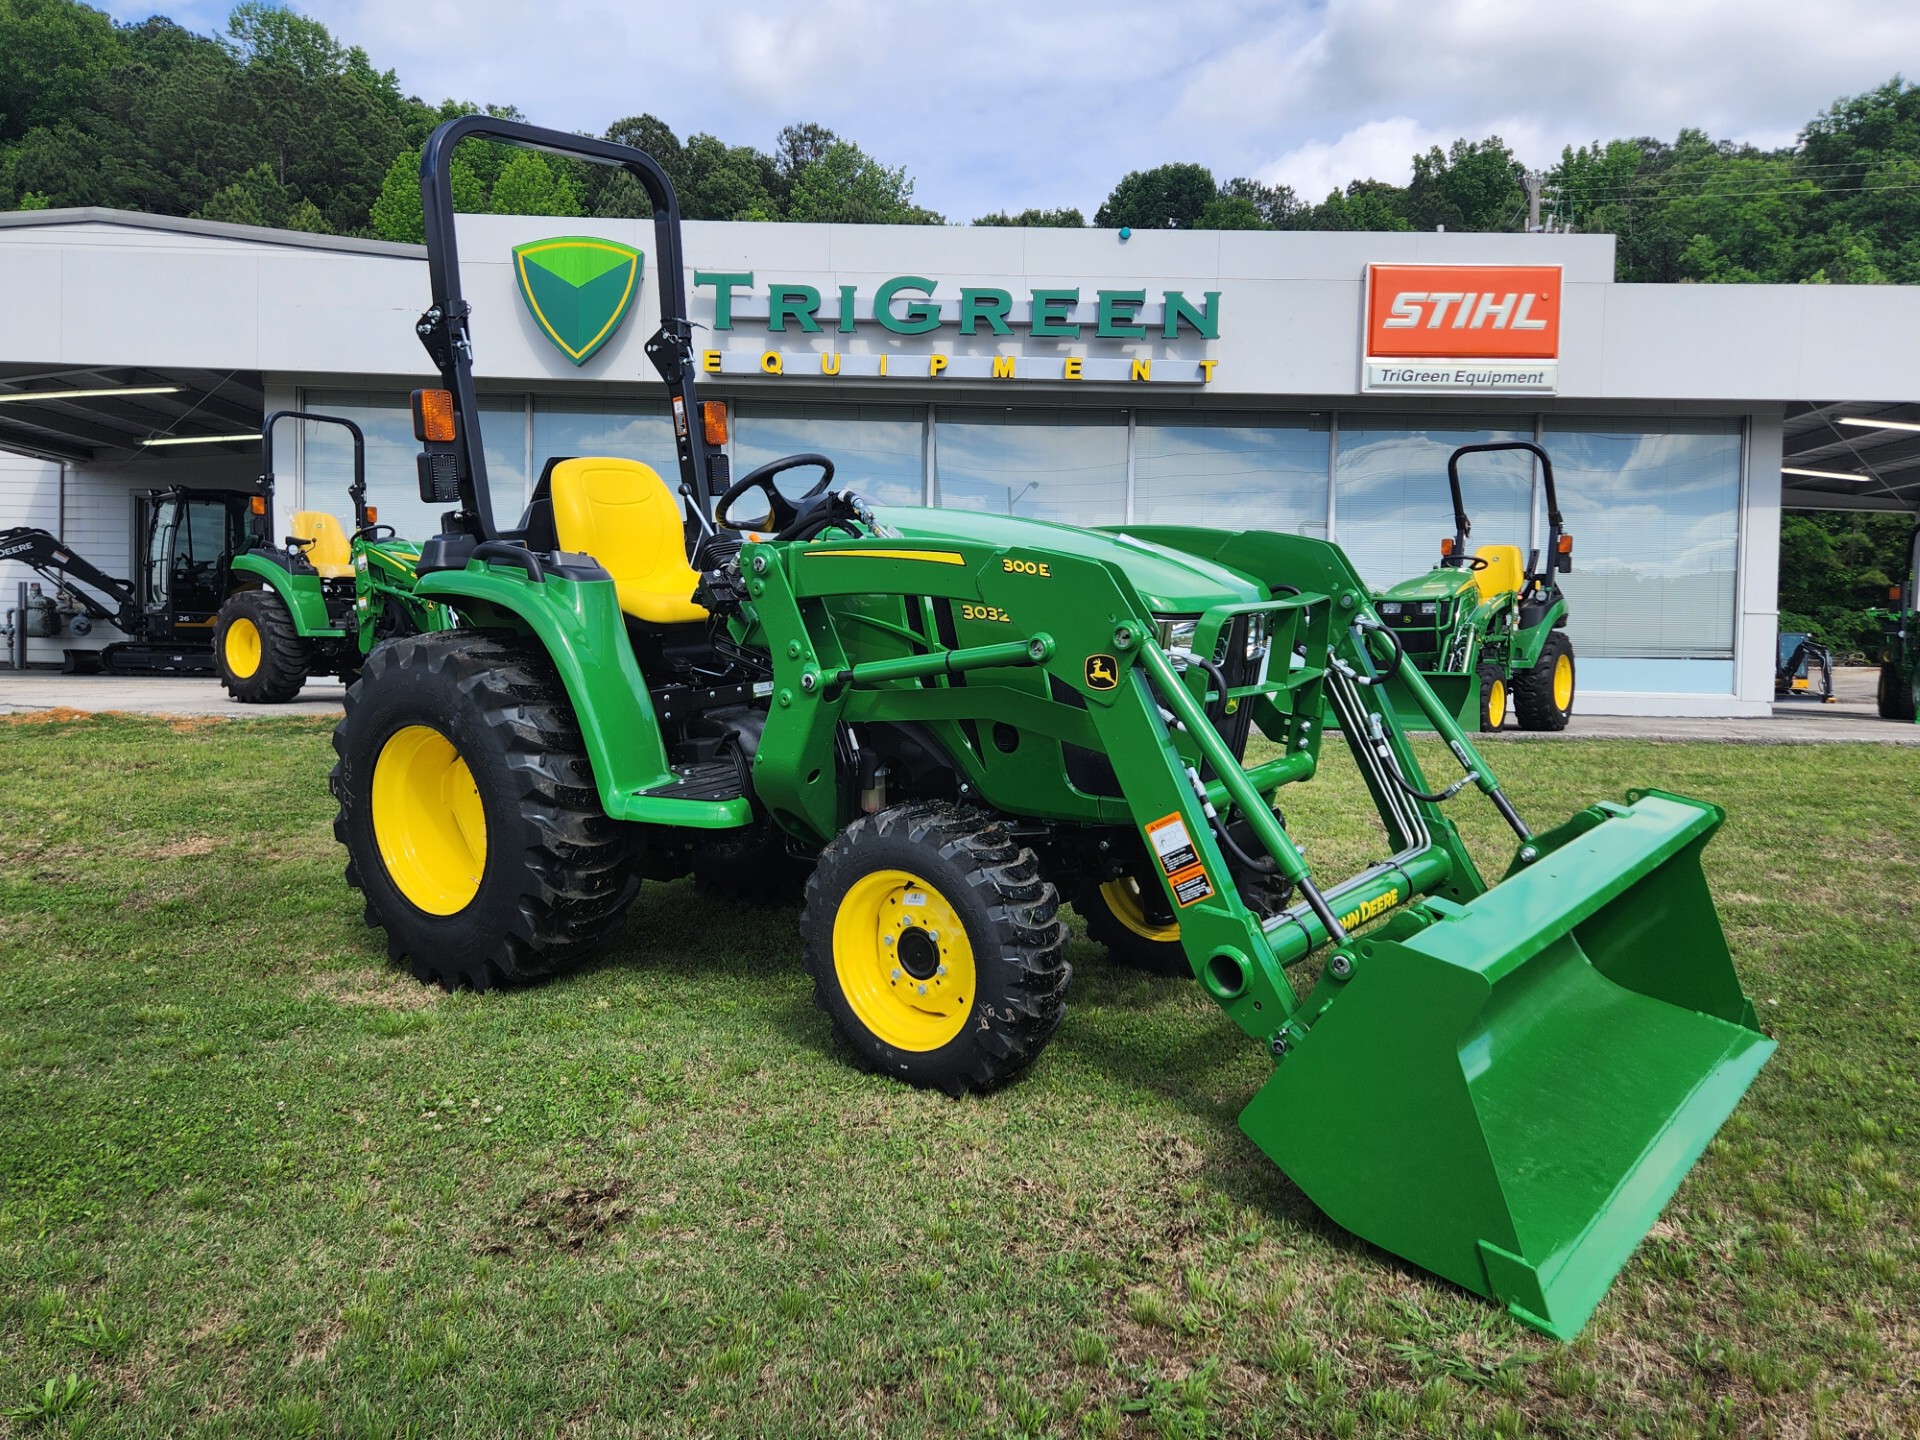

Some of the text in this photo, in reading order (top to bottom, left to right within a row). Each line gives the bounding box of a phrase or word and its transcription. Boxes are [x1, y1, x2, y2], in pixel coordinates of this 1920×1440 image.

[1382, 292, 1547, 330] STIHL
[703, 349, 1218, 383] EQUIPMENT
[1381, 369, 1544, 386] TriGreen Equipment
[1359, 888, 1398, 922] DEERE
